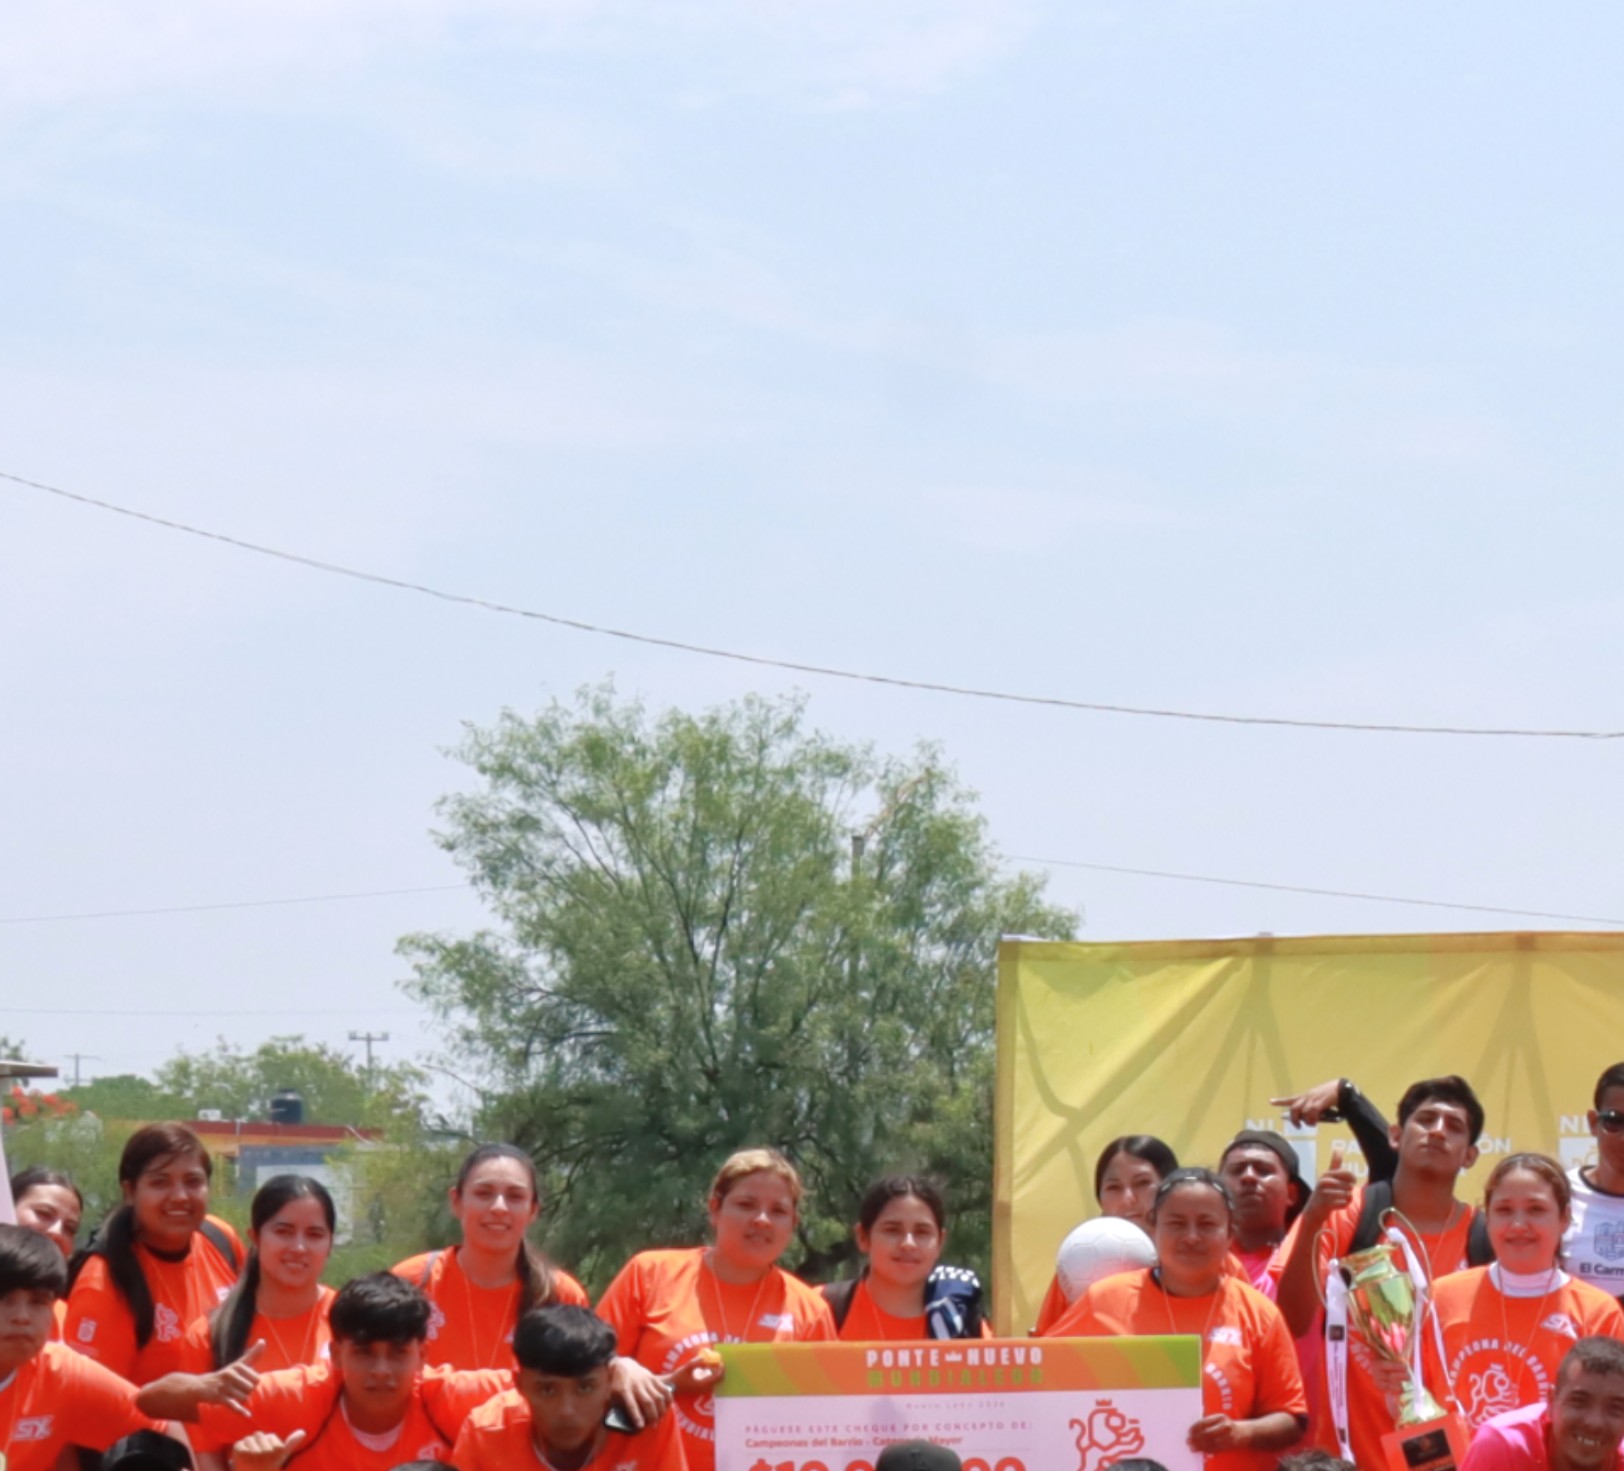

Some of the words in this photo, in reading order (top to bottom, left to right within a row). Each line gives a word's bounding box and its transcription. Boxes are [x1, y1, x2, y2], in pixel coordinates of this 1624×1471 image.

[1579, 1262, 1592, 1275] El
[866, 1348, 939, 1367] PONTE
[967, 1346, 1041, 1365] NUEVO
